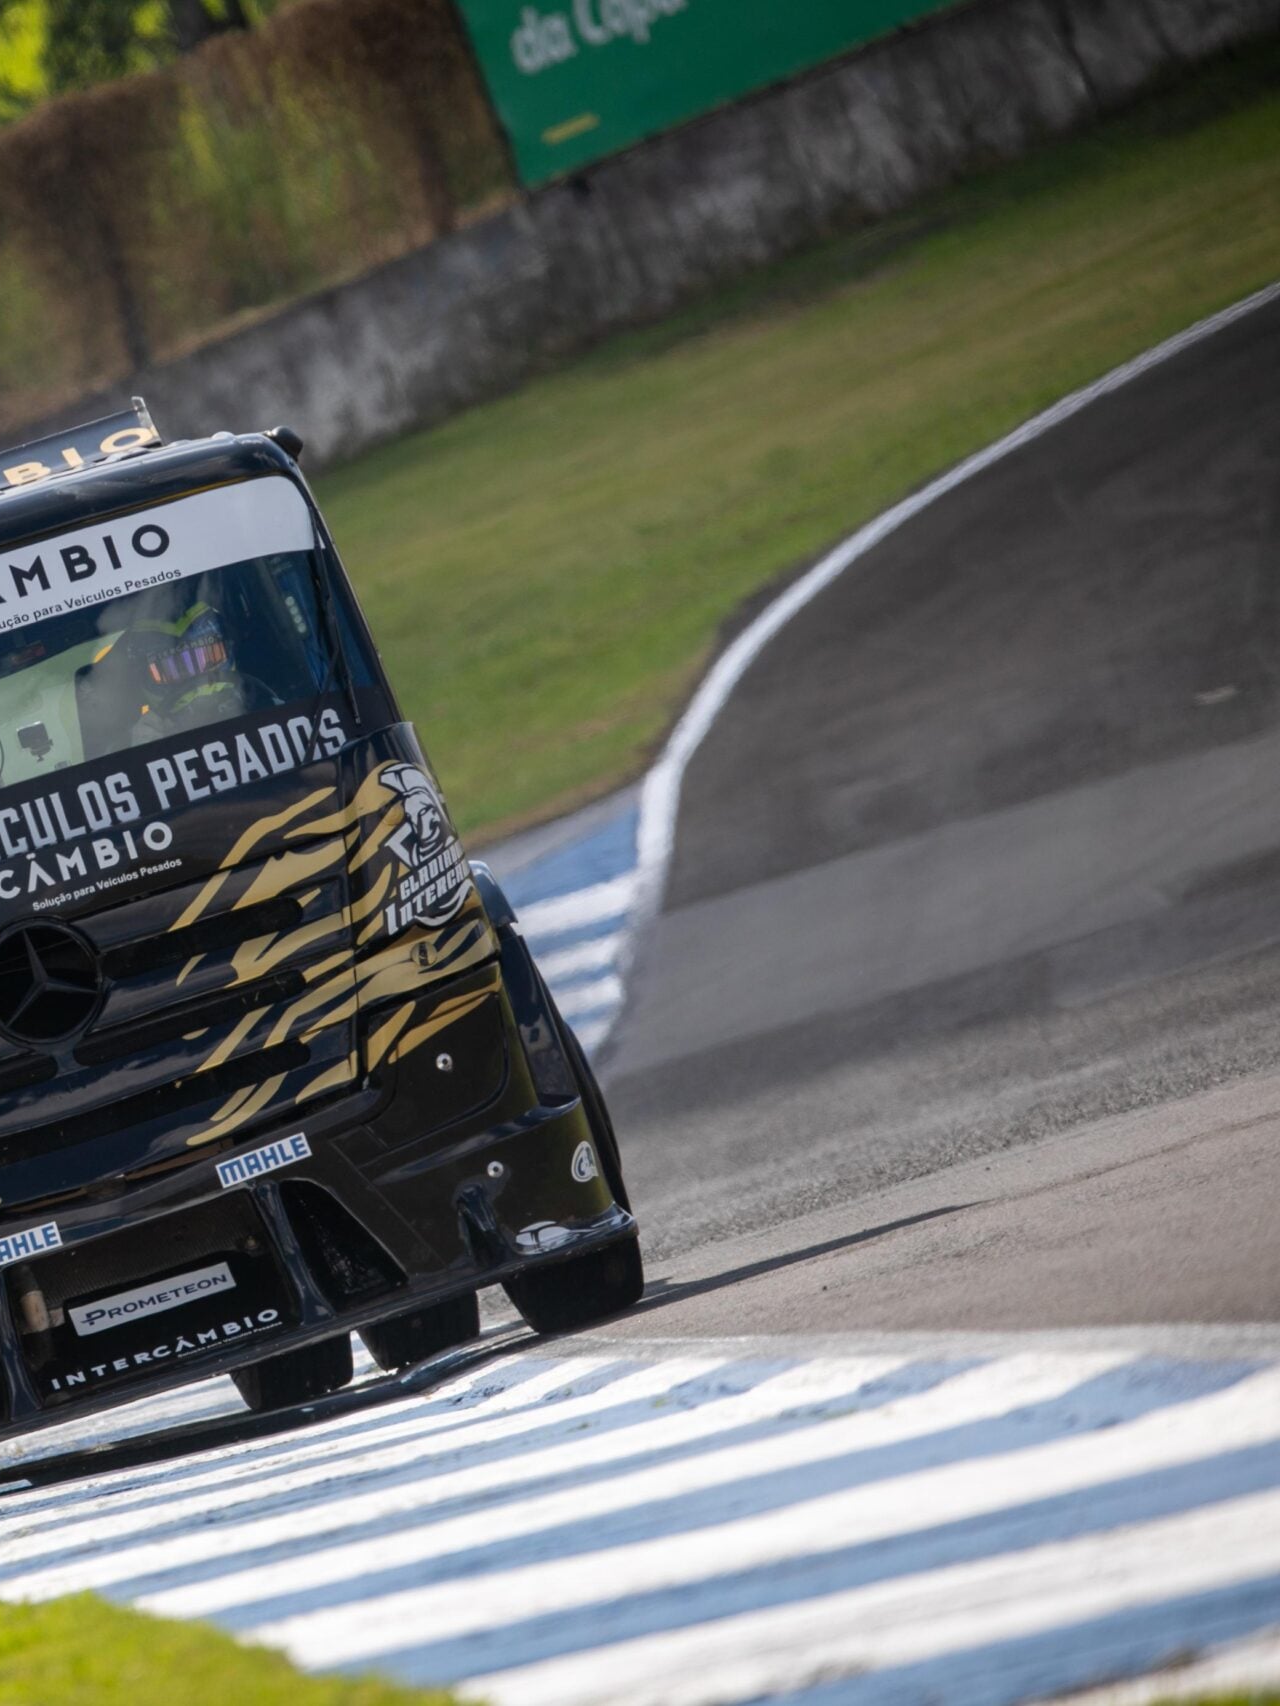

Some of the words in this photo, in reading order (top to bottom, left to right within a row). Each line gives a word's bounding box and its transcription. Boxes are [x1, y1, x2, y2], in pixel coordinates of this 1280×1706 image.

[511, 6, 578, 75] da
[33, 603, 63, 621] para
[124, 567, 182, 591] Pesados
[147, 708, 346, 810] PESADOS
[73, 885, 96, 900] para
[139, 857, 182, 877] Pesados
[219, 1135, 310, 1186] MAHLE
[81, 1273, 228, 1326] PROMETEON
[51, 1308, 279, 1390] INTERCÂMBIO
